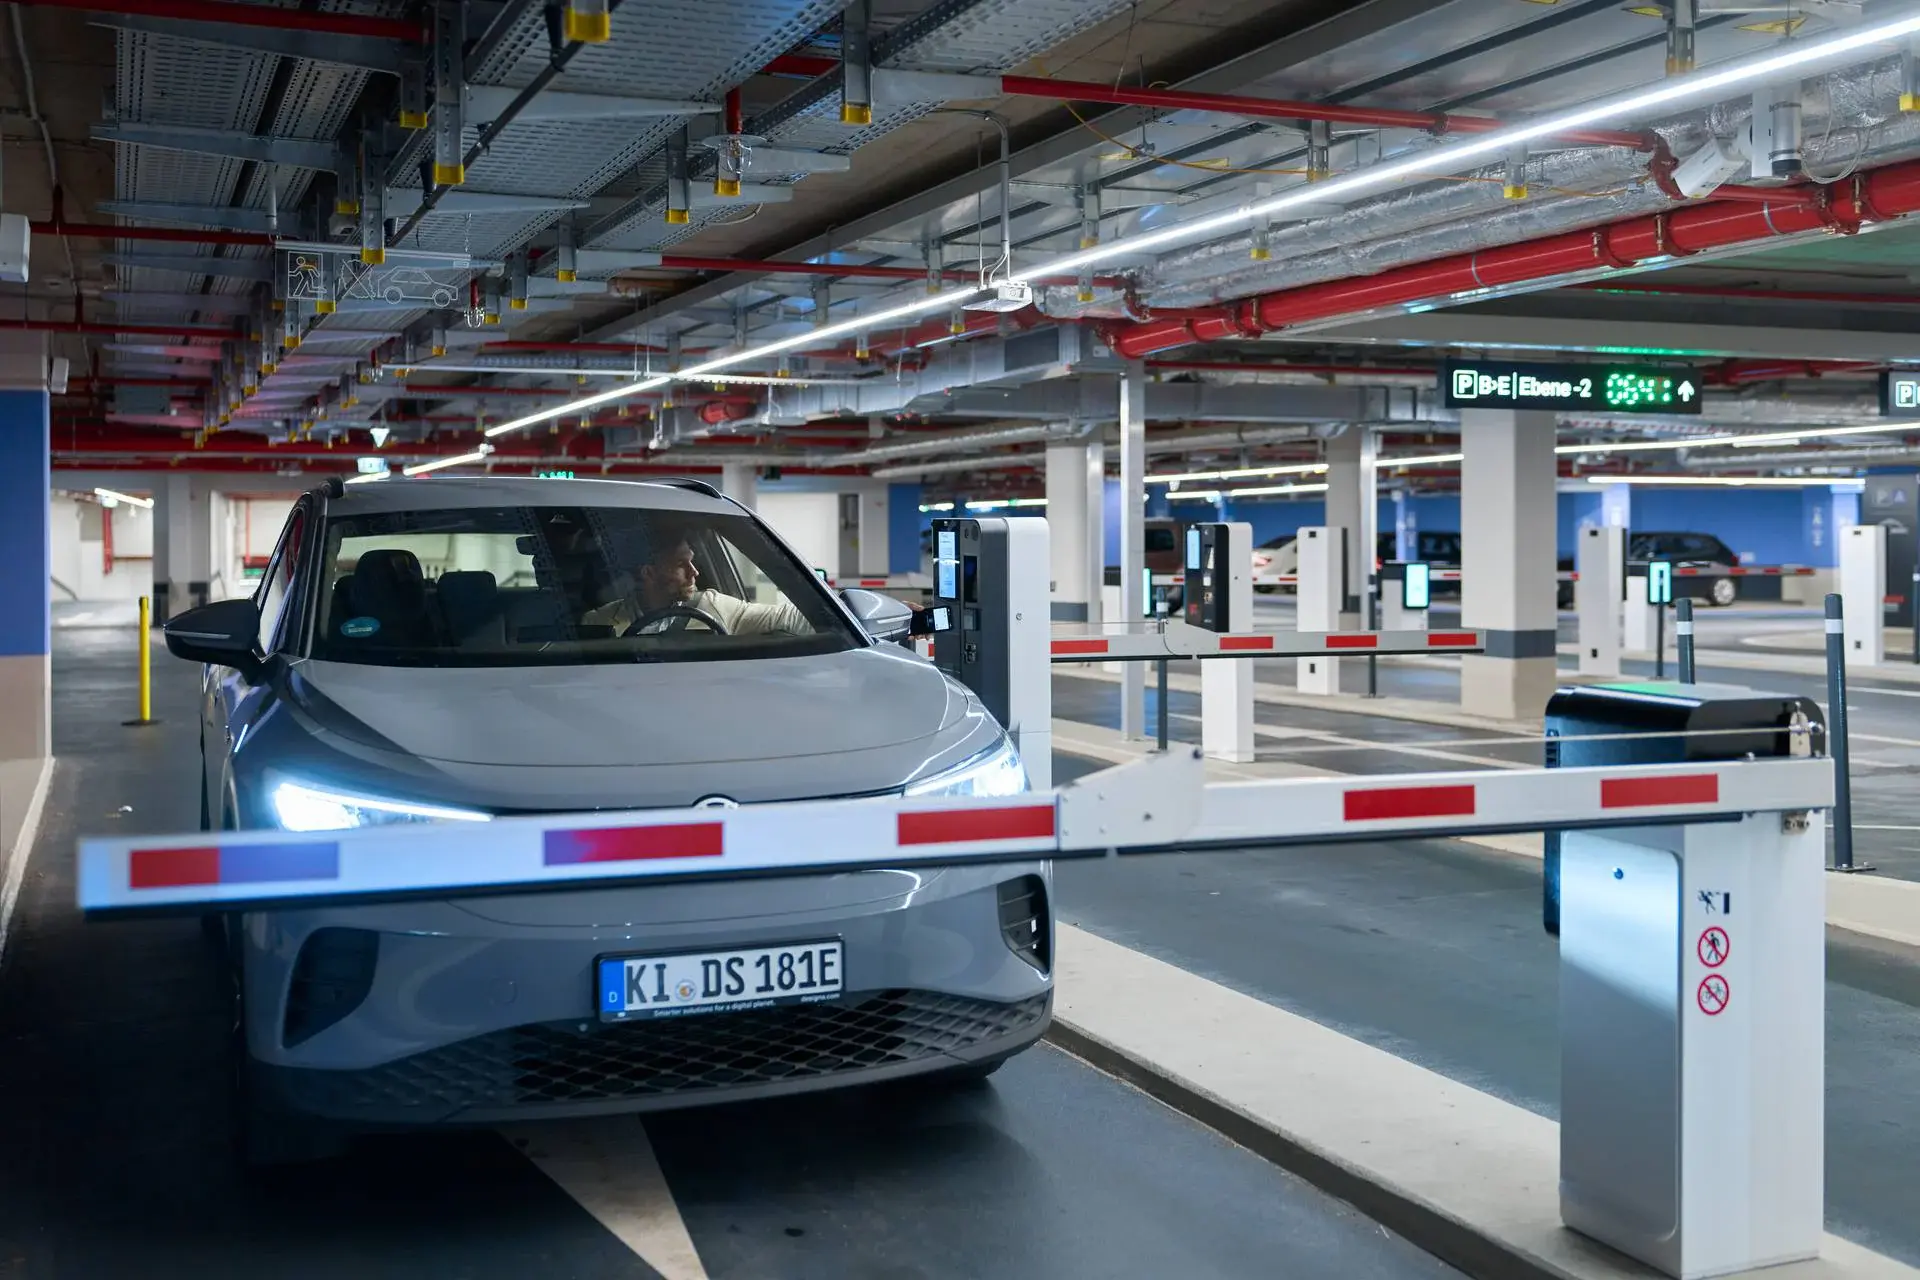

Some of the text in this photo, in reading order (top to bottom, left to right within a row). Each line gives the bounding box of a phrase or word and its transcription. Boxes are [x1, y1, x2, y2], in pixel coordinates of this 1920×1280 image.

[1518, 376, 1572, 397] Ebene
[625, 948, 839, 1004] KI DS 181E
[608, 991, 618, 1003] D
[654, 1008, 682, 1018] Smarter
[683, 1004, 714, 1015] solutions
[714, 1003, 724, 1012] for
[731, 1001, 753, 1011] digital
